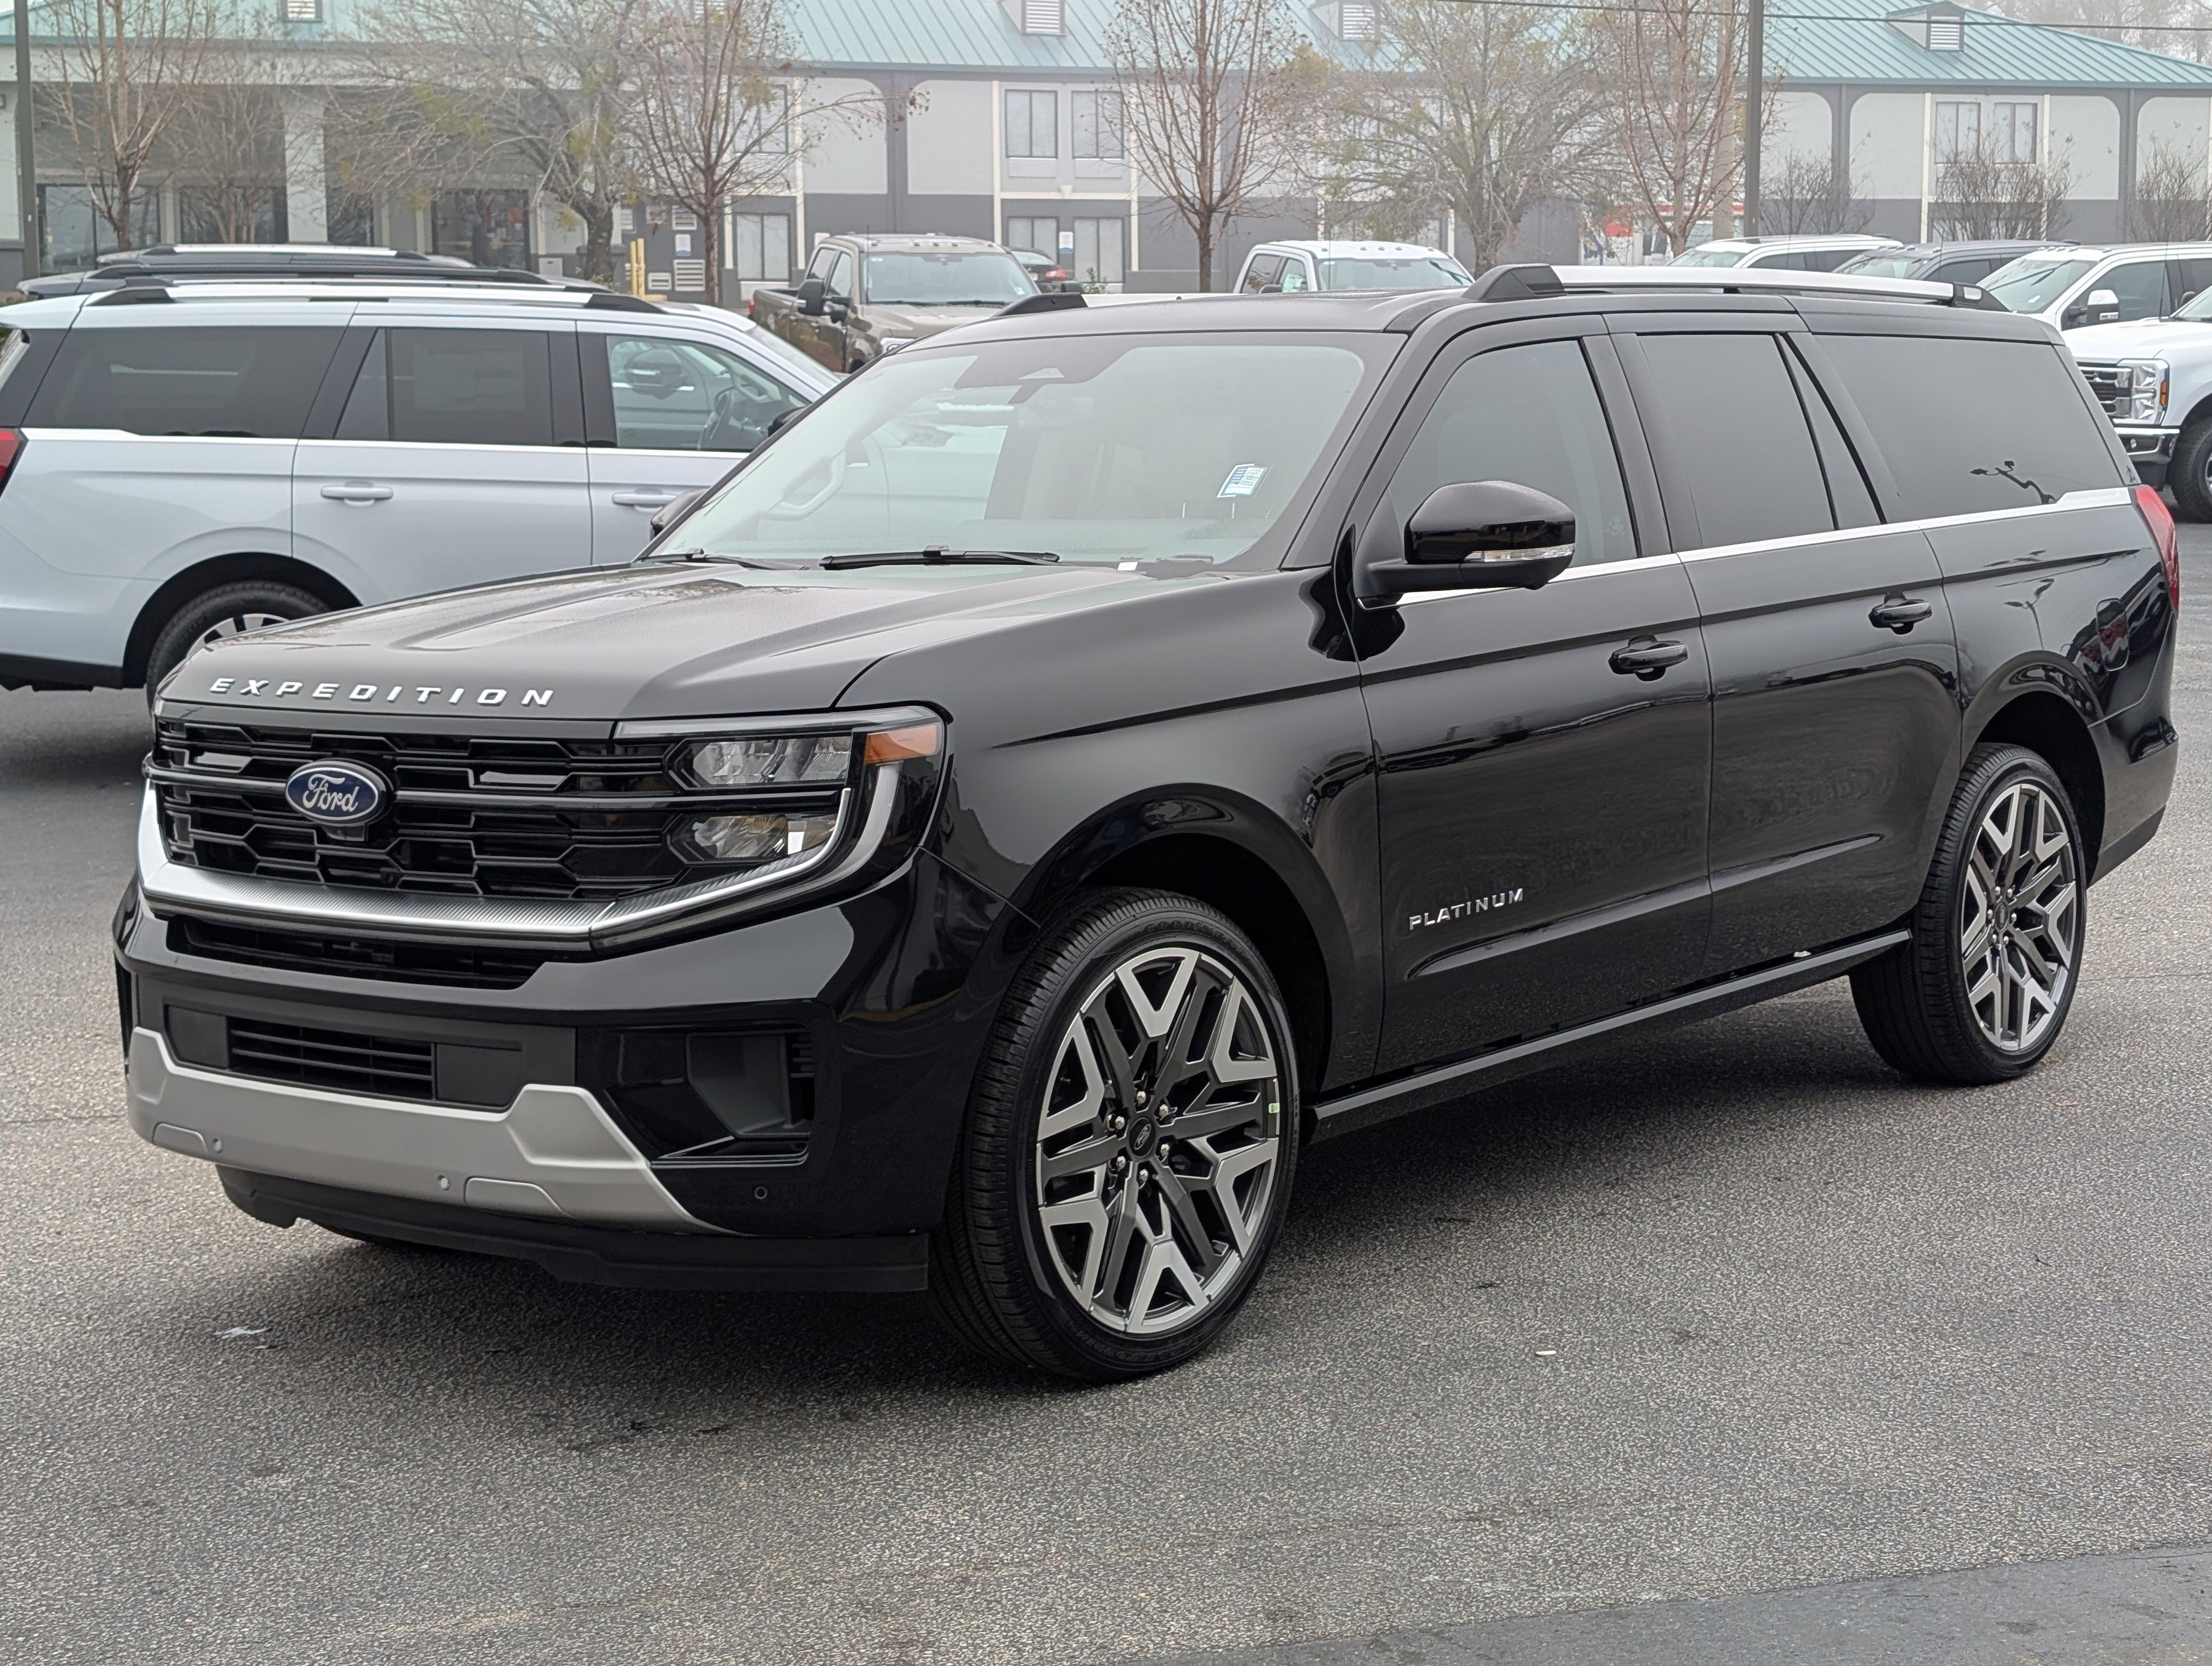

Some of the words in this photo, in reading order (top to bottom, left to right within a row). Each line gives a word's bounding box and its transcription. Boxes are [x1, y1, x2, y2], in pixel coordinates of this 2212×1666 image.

[210, 677, 554, 706] EXPEDITION
[302, 773, 360, 812] Ford
[1409, 888, 1523, 931] PLATINUM
